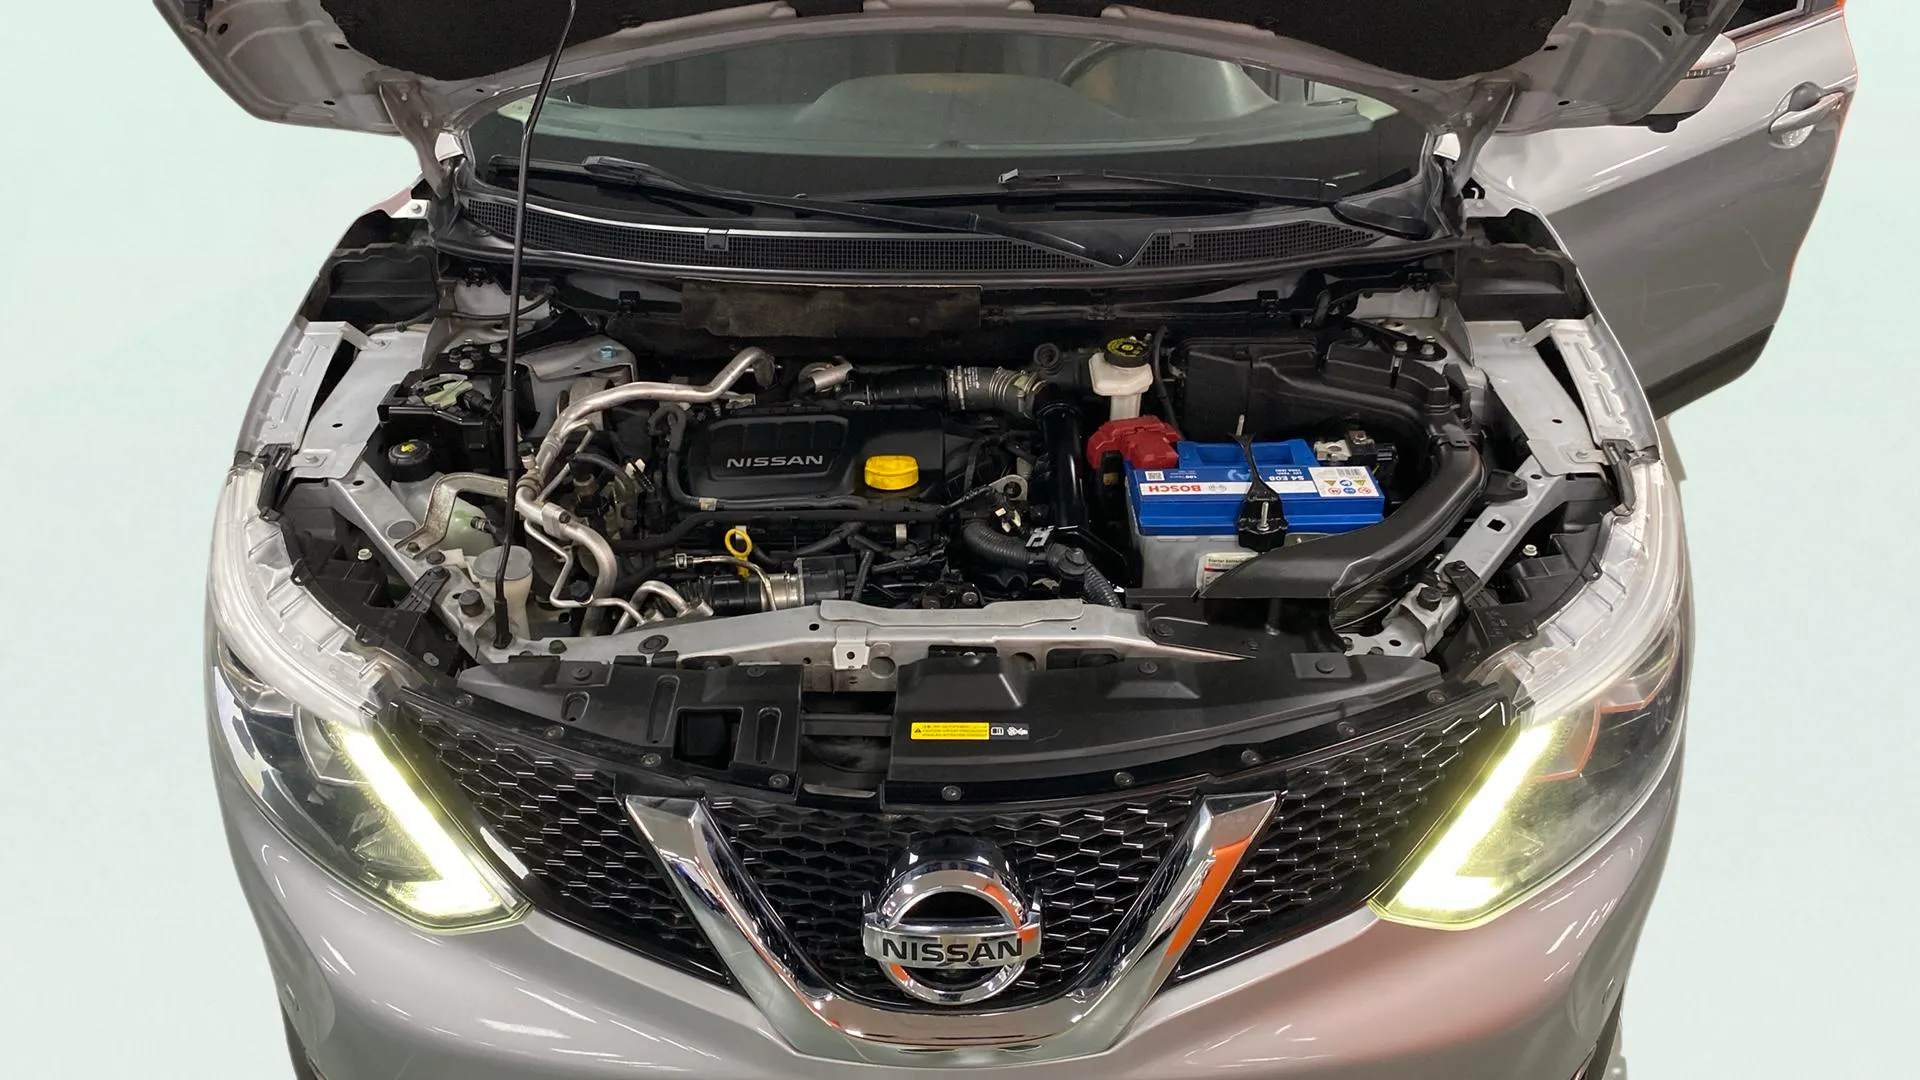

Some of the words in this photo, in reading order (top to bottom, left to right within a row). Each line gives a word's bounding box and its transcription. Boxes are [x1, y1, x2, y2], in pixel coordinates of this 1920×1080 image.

[727, 455, 823, 468] NISSAN
[1148, 484, 1202, 493] BOSCH
[882, 938, 1023, 963] NISSAN
